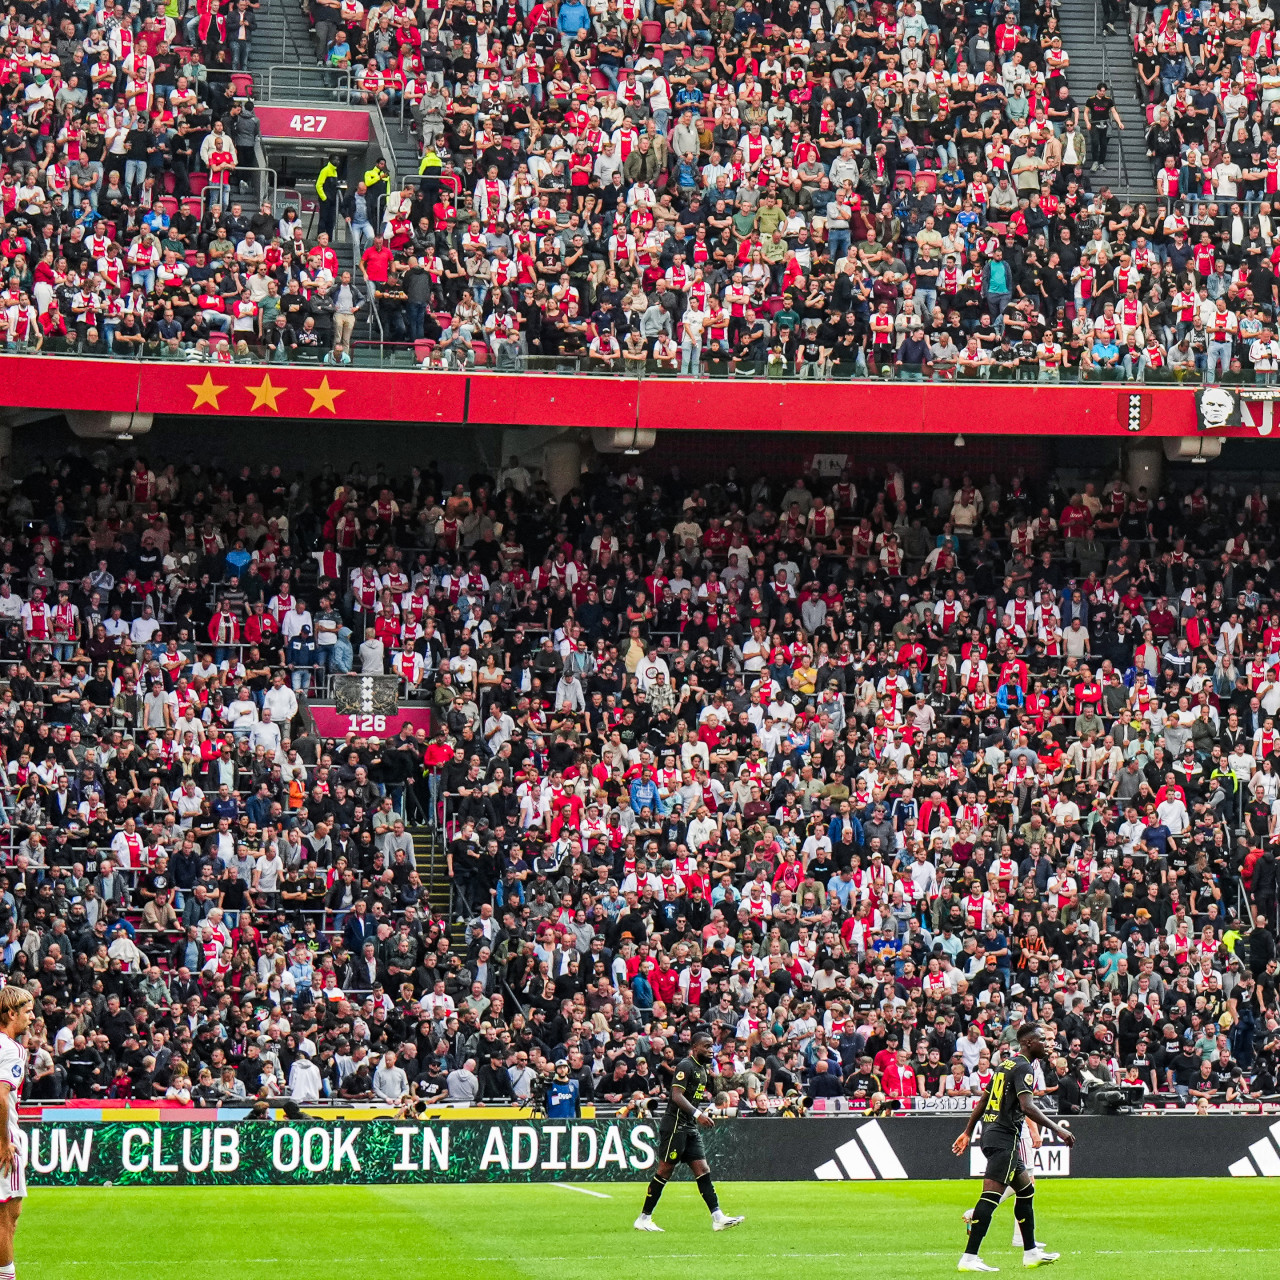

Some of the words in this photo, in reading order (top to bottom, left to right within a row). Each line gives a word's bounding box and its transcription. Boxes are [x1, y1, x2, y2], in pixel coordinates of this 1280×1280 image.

[290, 115, 327, 132] 427
[348, 714, 386, 731] 126
[24, 1127, 93, 1172] UW
[122, 1127, 240, 1173] CLUB
[272, 1127, 362, 1172] OOK
[393, 1126, 450, 1172] IN
[480, 1125, 655, 1171] ADIDAS
